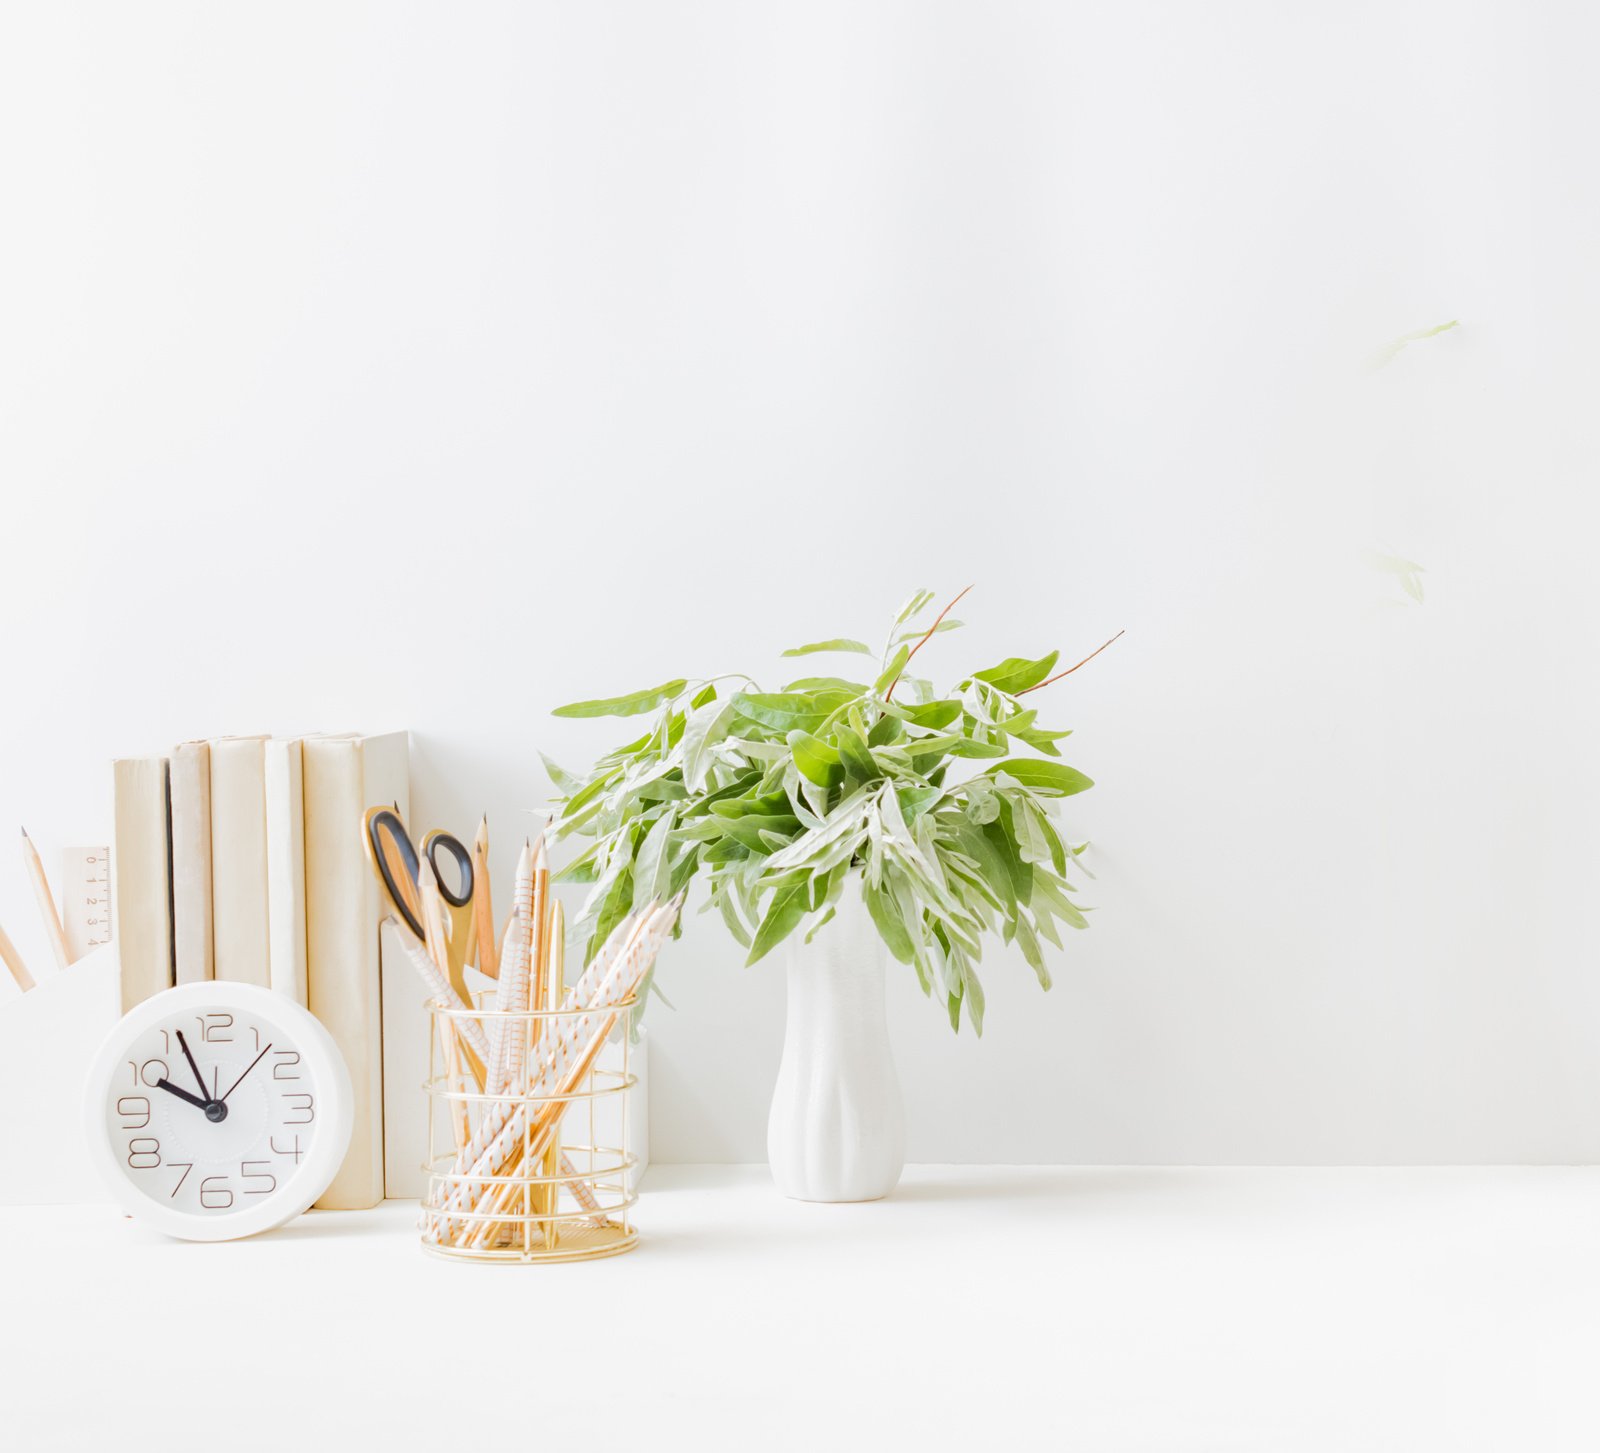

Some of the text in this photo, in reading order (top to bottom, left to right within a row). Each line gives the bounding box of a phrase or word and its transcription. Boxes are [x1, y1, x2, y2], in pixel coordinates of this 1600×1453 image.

[159, 1029, 186, 1054] 1
[195, 1014, 234, 1042] 12
[249, 1027, 259, 1051] 1
[128, 1059, 170, 1088] 10
[273, 1051, 301, 1080] 2
[117, 1096, 151, 1129] 9
[281, 1093, 315, 1125] 3
[127, 1137, 162, 1169] 8
[270, 1134, 304, 1165] 4
[166, 1163, 194, 1198] 7
[200, 1176, 234, 1209] 6
[241, 1160, 277, 1194] 5
